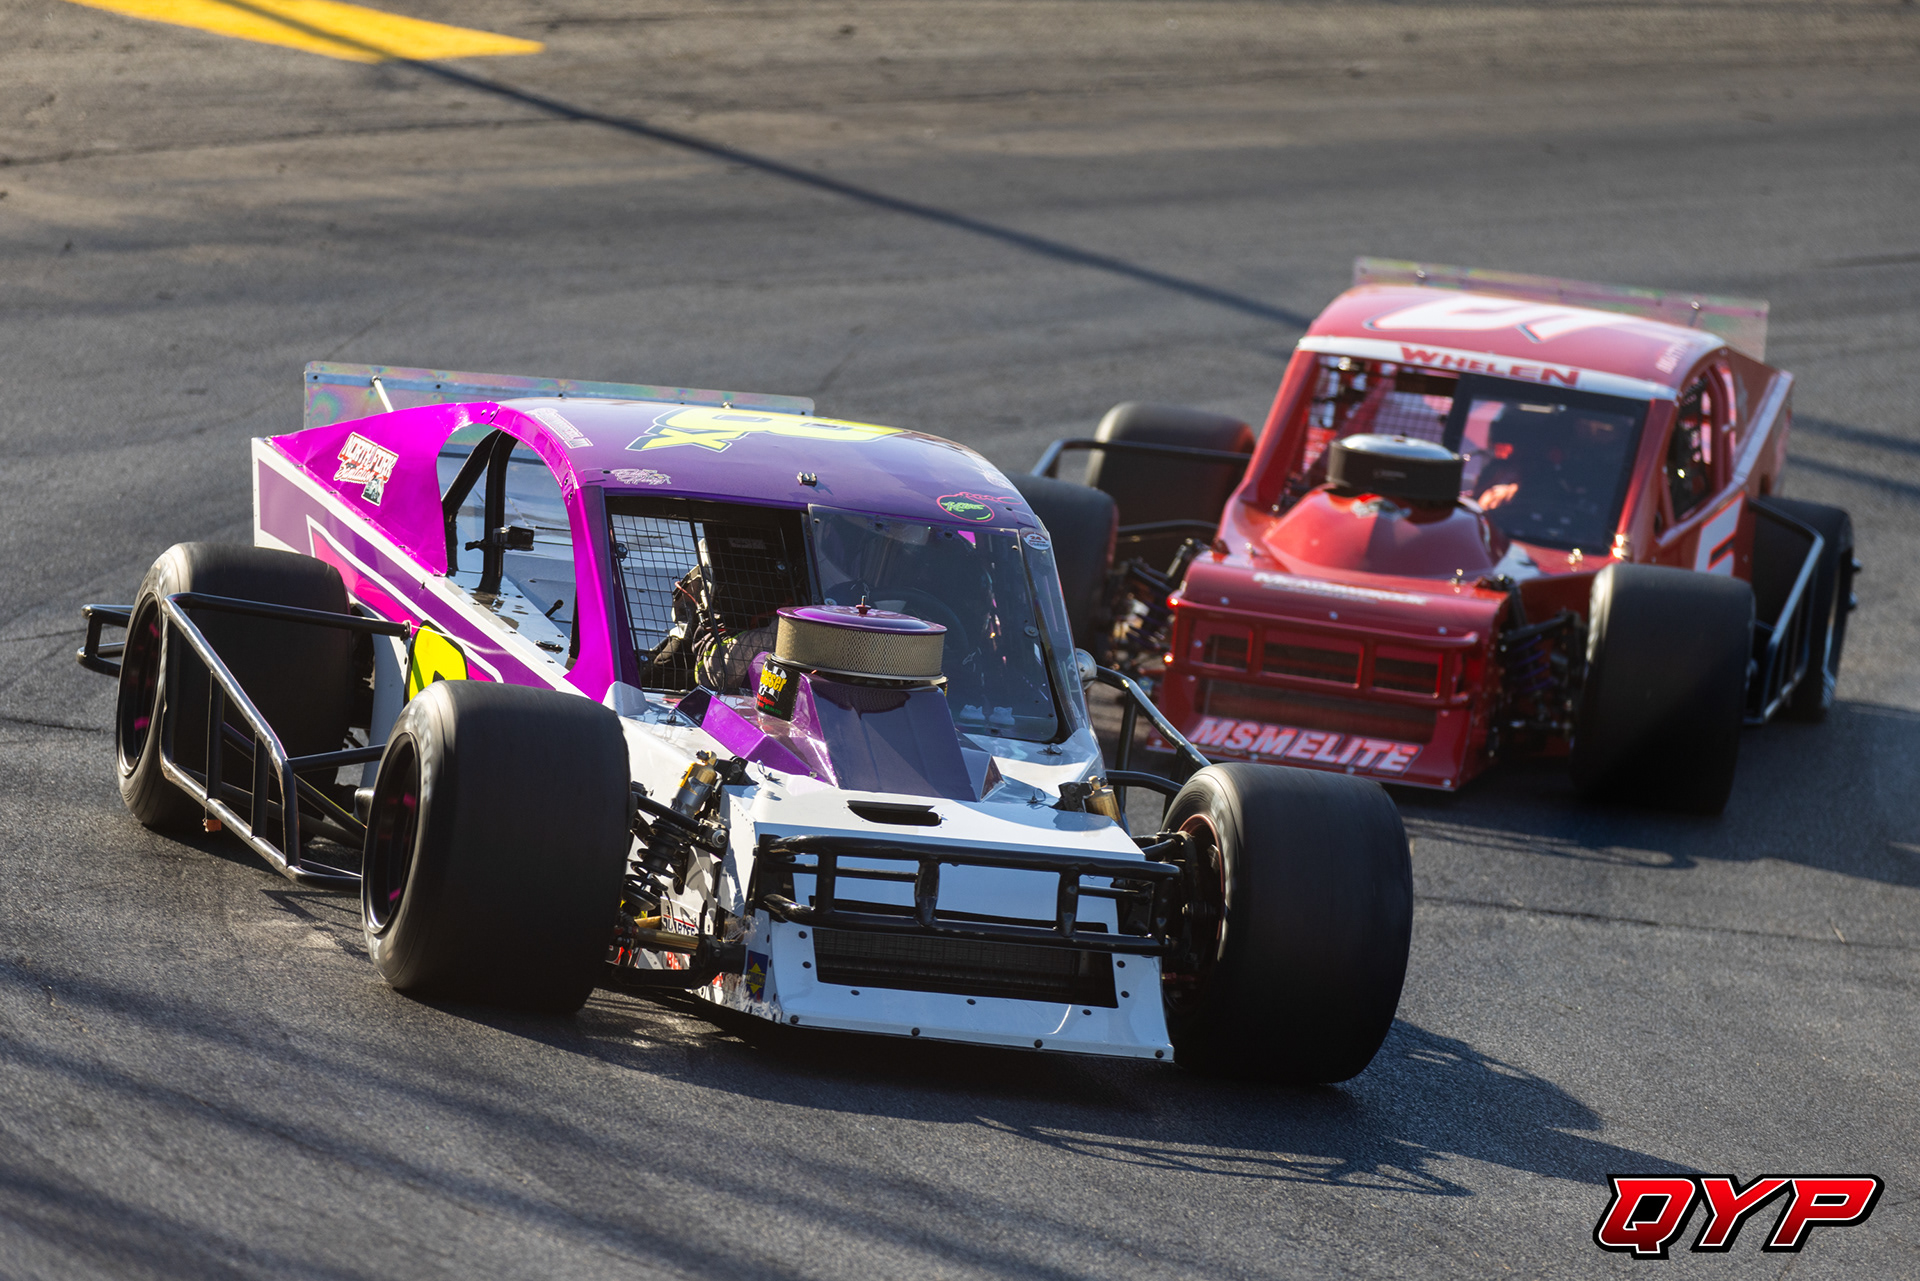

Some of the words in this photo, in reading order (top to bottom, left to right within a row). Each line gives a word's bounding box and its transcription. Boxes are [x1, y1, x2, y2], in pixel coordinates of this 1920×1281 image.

[1400, 346, 1580, 388] WHELEN
[339, 433, 377, 467] NORTH
[369, 446, 399, 481] FORK
